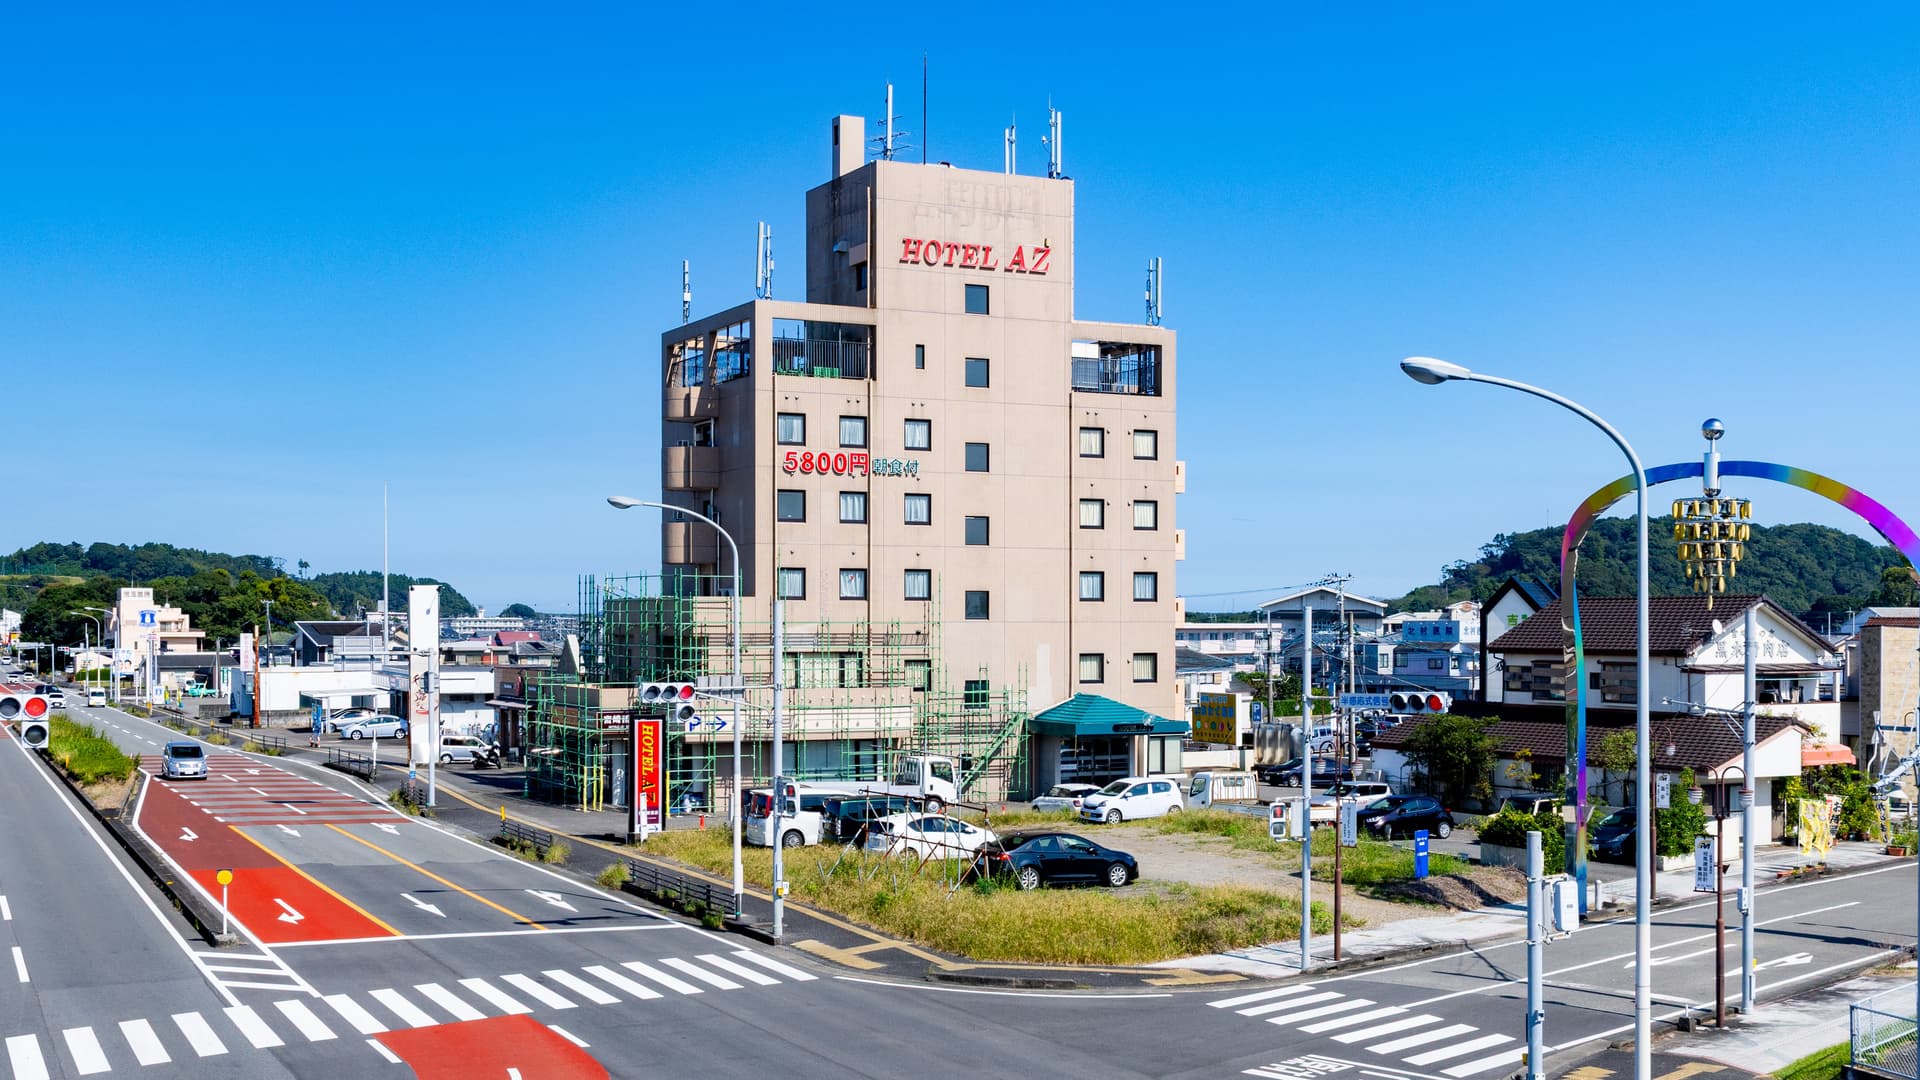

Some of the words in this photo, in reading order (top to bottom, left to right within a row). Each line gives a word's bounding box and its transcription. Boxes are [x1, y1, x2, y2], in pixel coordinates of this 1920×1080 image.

[900, 238, 998, 269] HOTEL
[1004, 243, 1053, 274] AZ
[783, 451, 870, 475] 5800円
[873, 458, 920, 475] 朝食付
[641, 724, 655, 776] HOTEL
